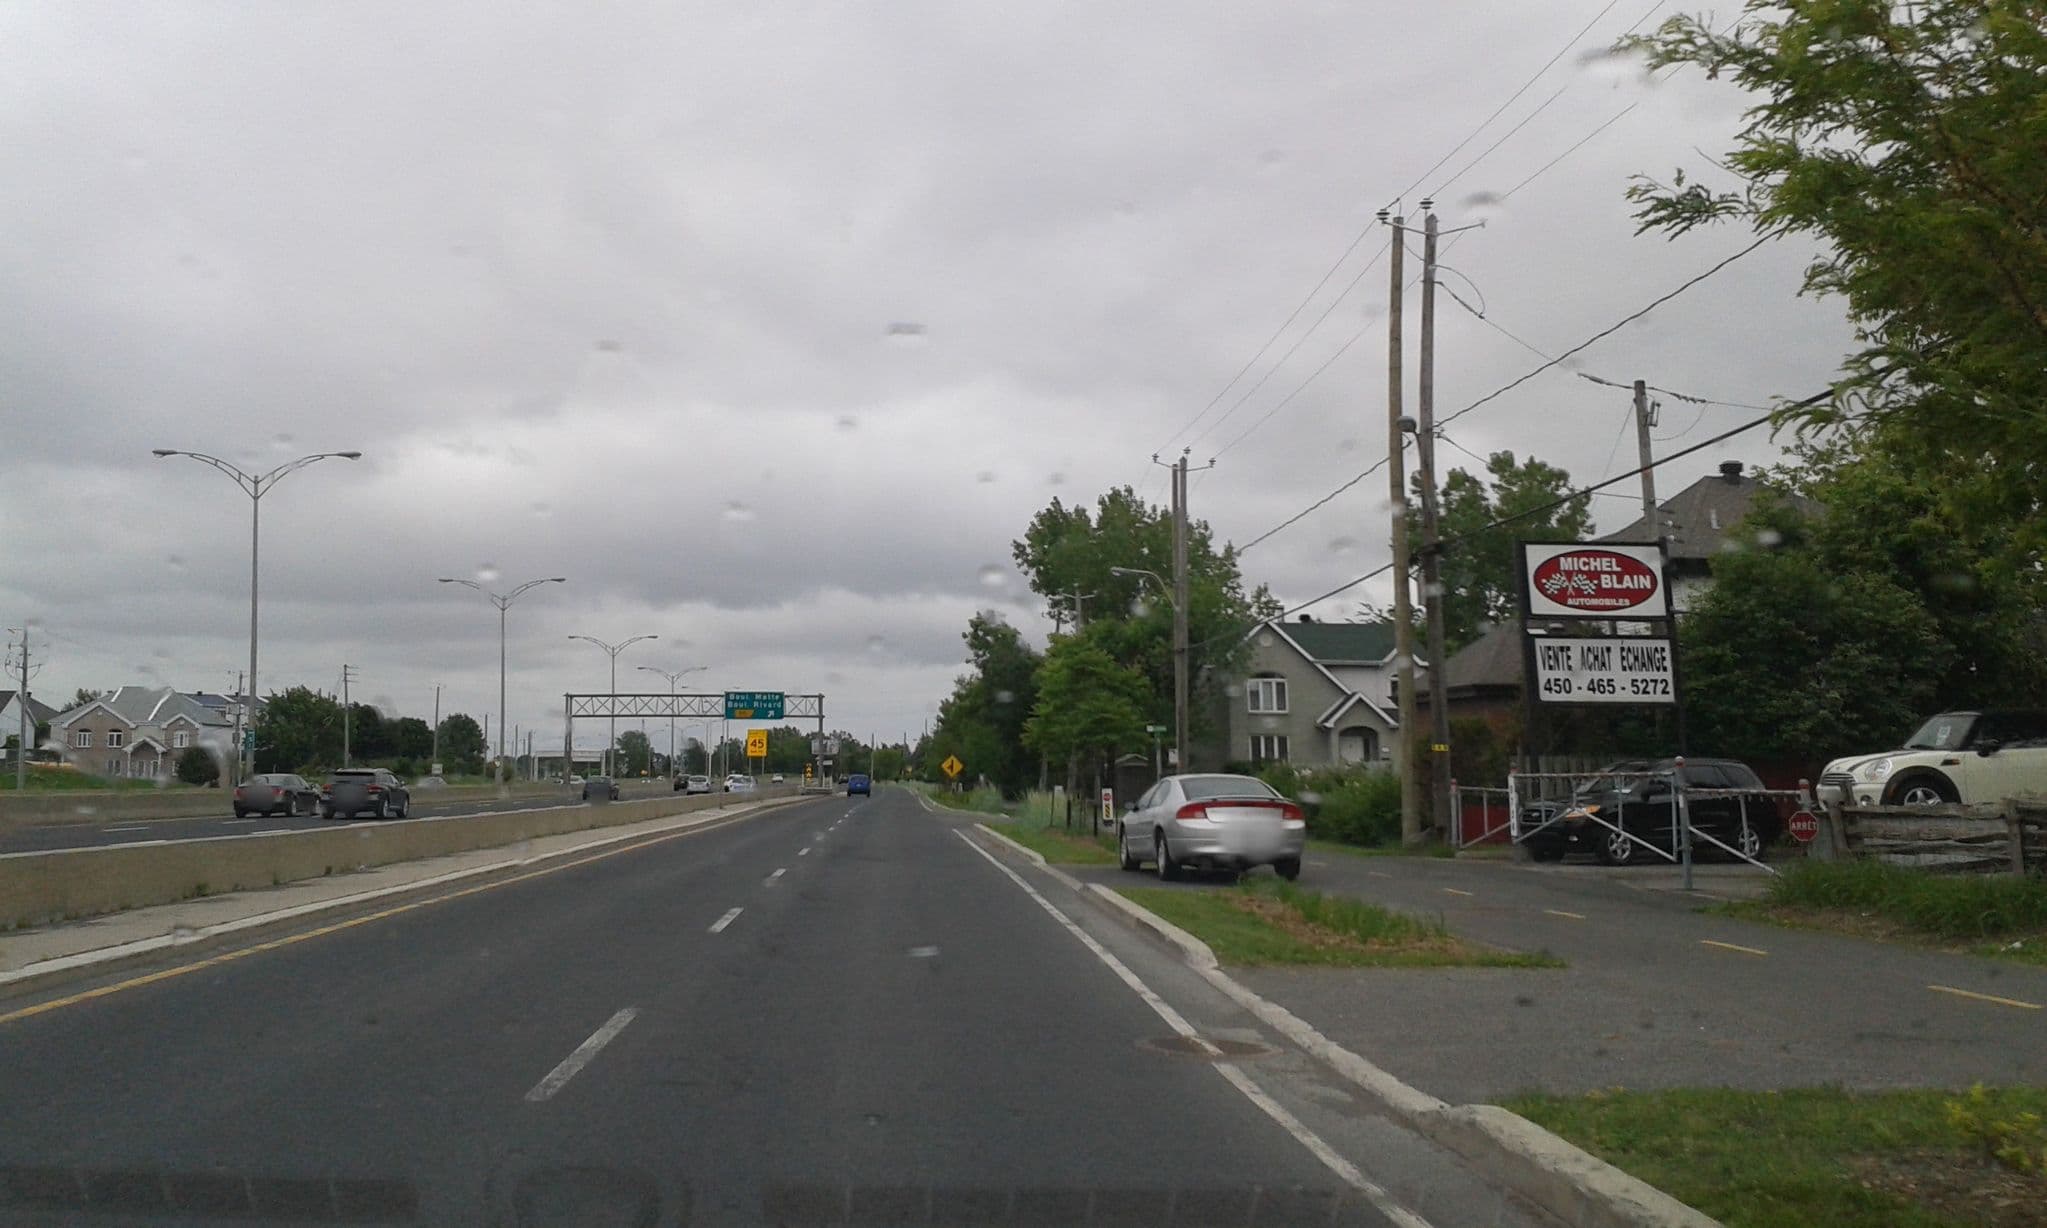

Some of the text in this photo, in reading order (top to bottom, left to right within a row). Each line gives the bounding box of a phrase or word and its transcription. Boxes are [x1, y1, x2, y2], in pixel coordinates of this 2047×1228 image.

[1559, 556, 1622, 572] MICHEL
[1600, 574, 1652, 590] BLAIN
[1566, 597, 1631, 606] AUTOMOBILES
[1539, 642, 1668, 672] VENTE ACHAT ÉCHANGE
[1543, 677, 1572, 694] 450
[1587, 678, 1616, 694] 465
[1630, 678, 1670, 695] 5272
[750, 738, 765, 749] 45
